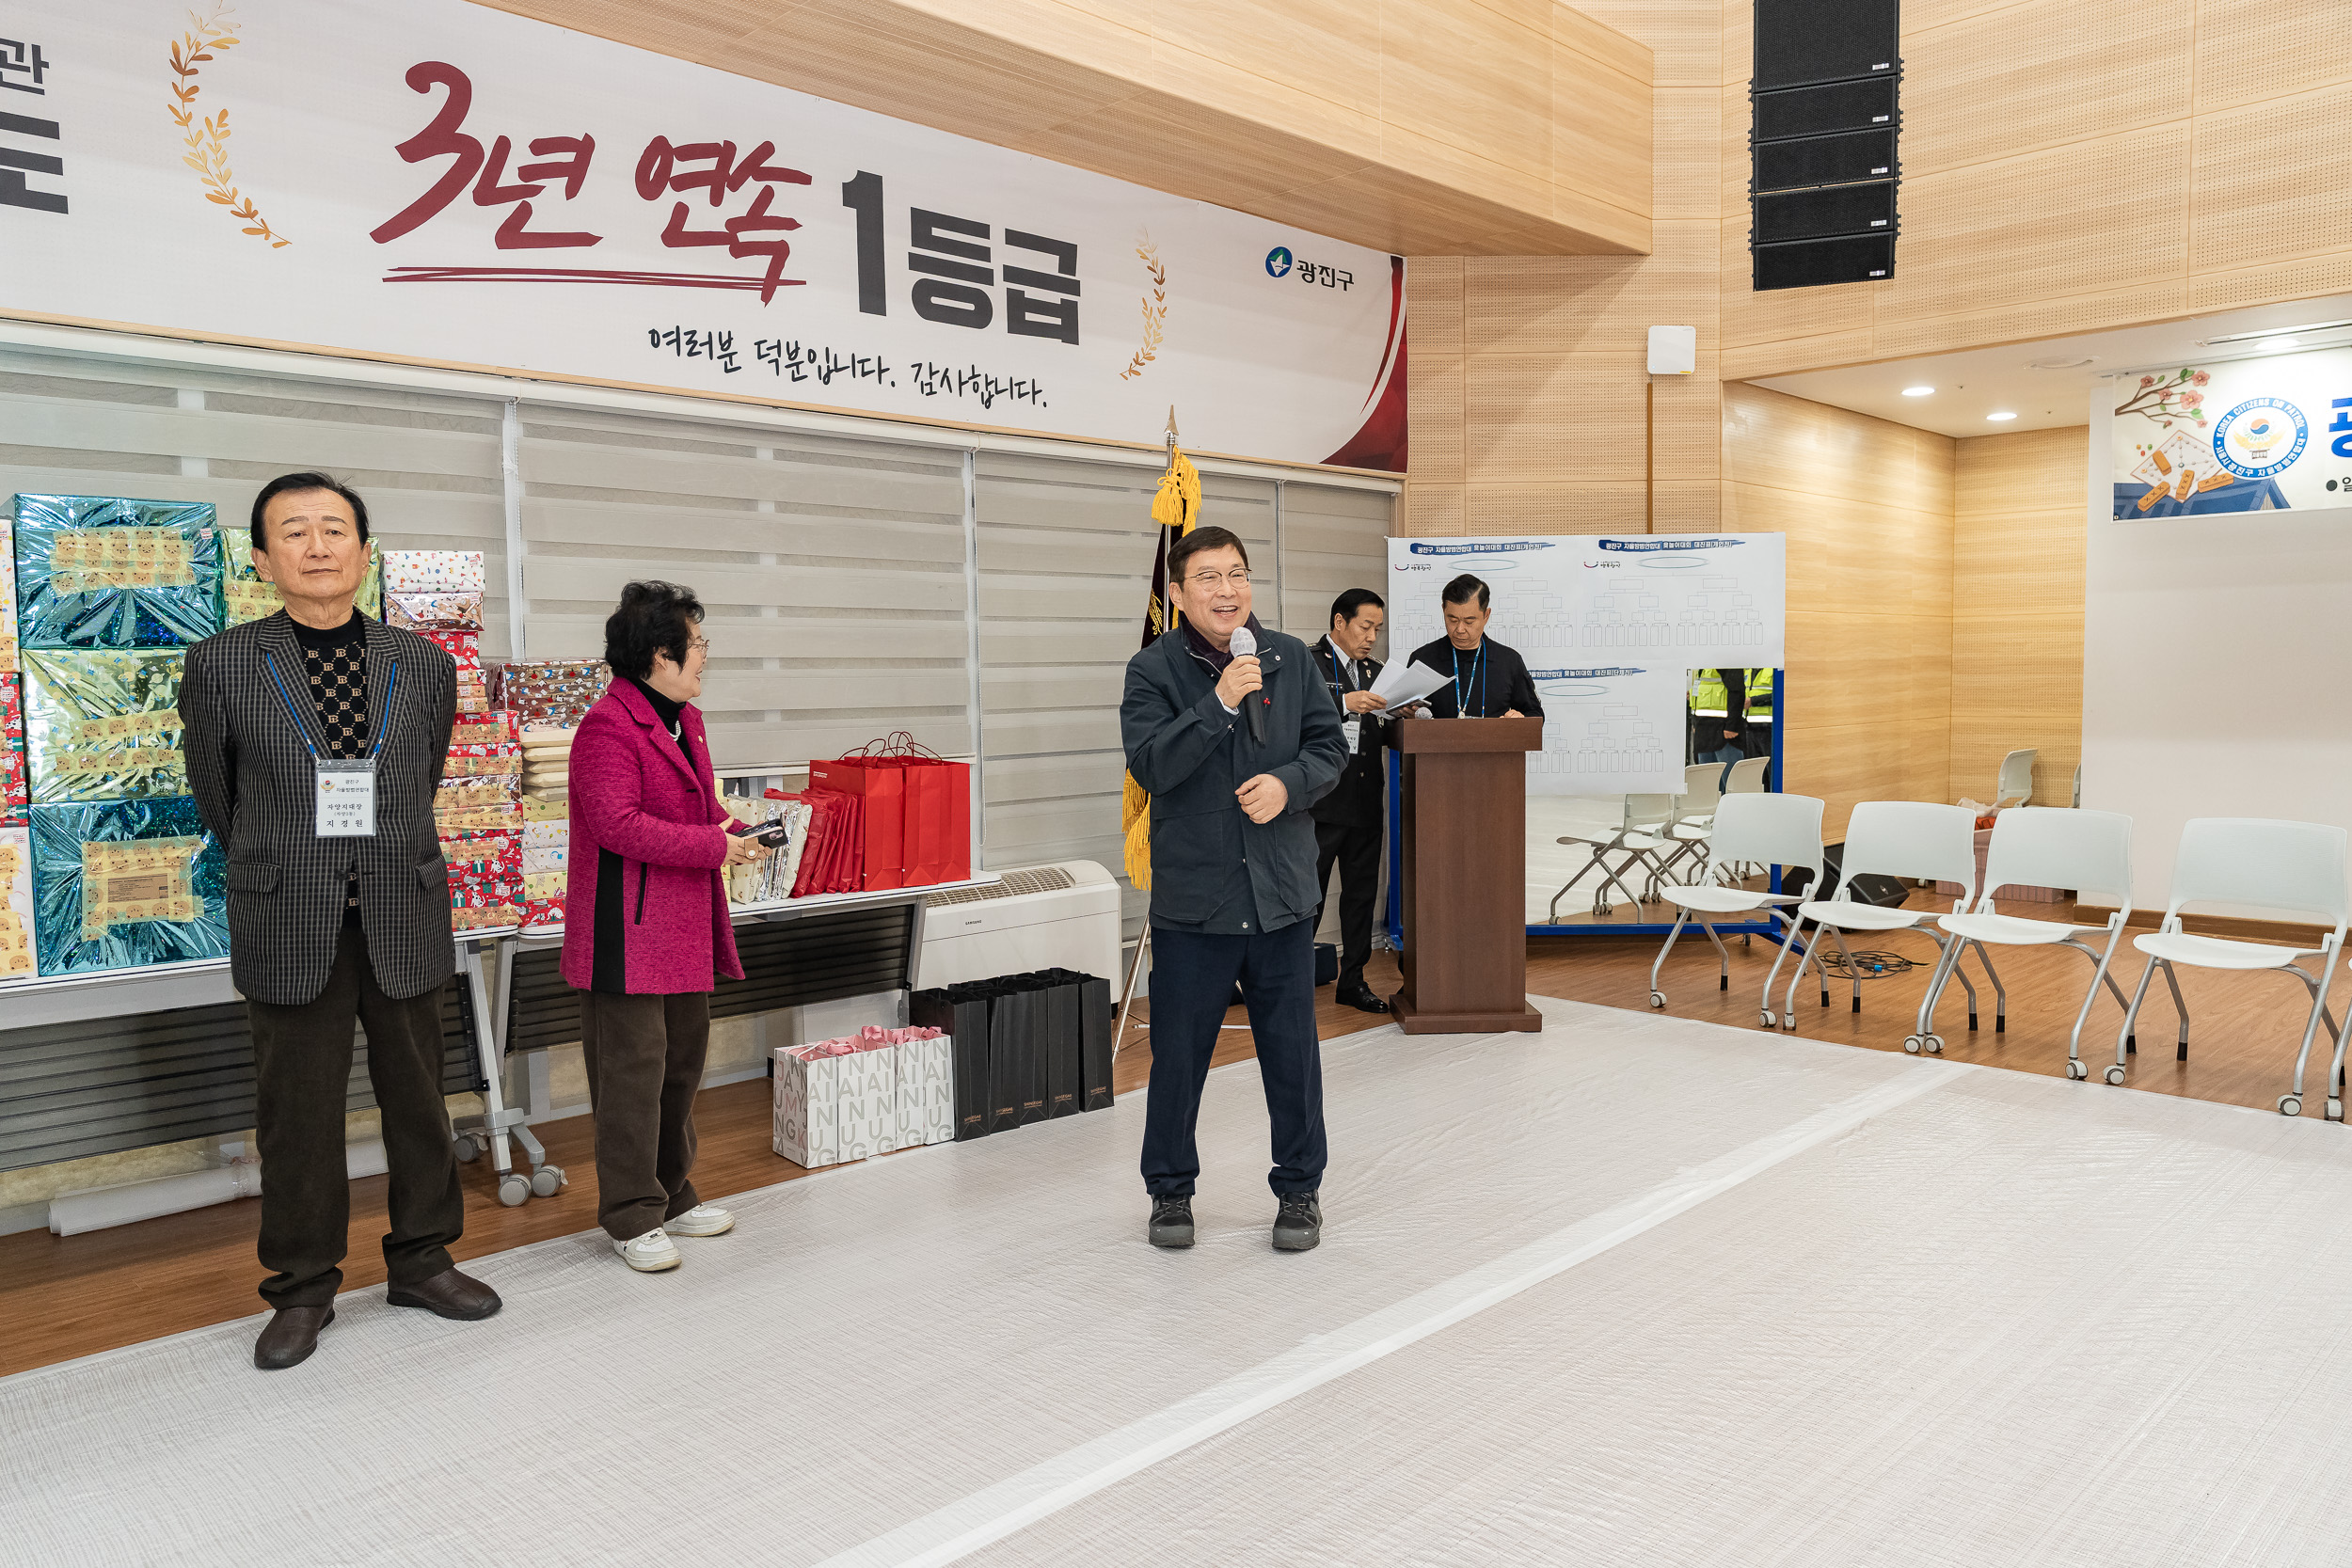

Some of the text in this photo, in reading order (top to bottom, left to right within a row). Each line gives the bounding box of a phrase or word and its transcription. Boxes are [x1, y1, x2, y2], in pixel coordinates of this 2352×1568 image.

[369, 60, 1081, 345] 3년 연속 1등급
[1296, 260, 1355, 292] 광진구
[648, 325, 1047, 409] 여러분 덕분입니다. 감사합니다.
[2216, 398, 2306, 437] KOREA CITIZENS ON PATROL
[1605, 542, 1622, 550] 광진구
